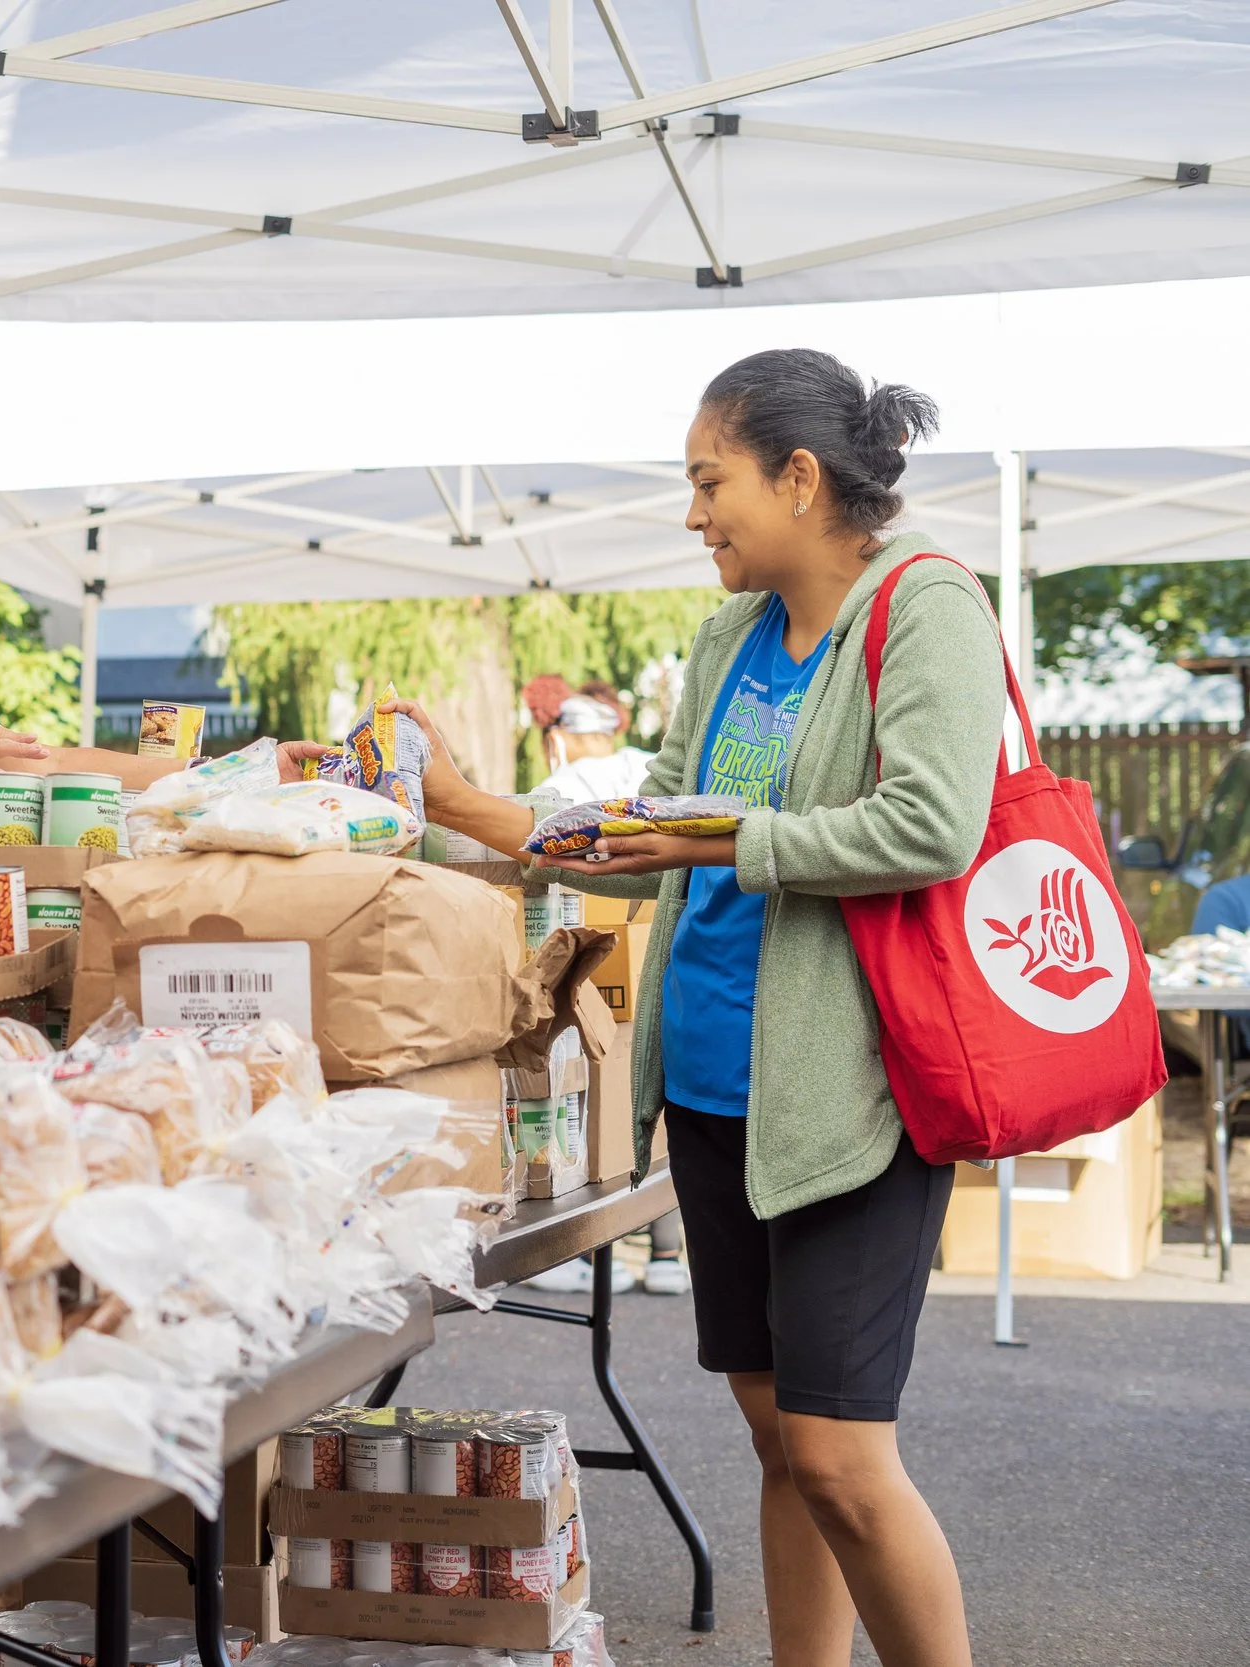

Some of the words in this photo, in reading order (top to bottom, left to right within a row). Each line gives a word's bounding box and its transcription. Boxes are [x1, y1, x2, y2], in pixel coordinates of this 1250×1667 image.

[4, 804, 29, 814] Sweet
[542, 833, 592, 855] Fiesta
[180, 1011, 215, 1021] GRAIN
[217, 1011, 262, 1020] MEDIUM
[430, 1547, 446, 1555] LIGHT
[521, 1550, 539, 1559] LIGHT
[424, 1554, 444, 1563] KIDNEY
[515, 1559, 538, 1567] KIDNEY
